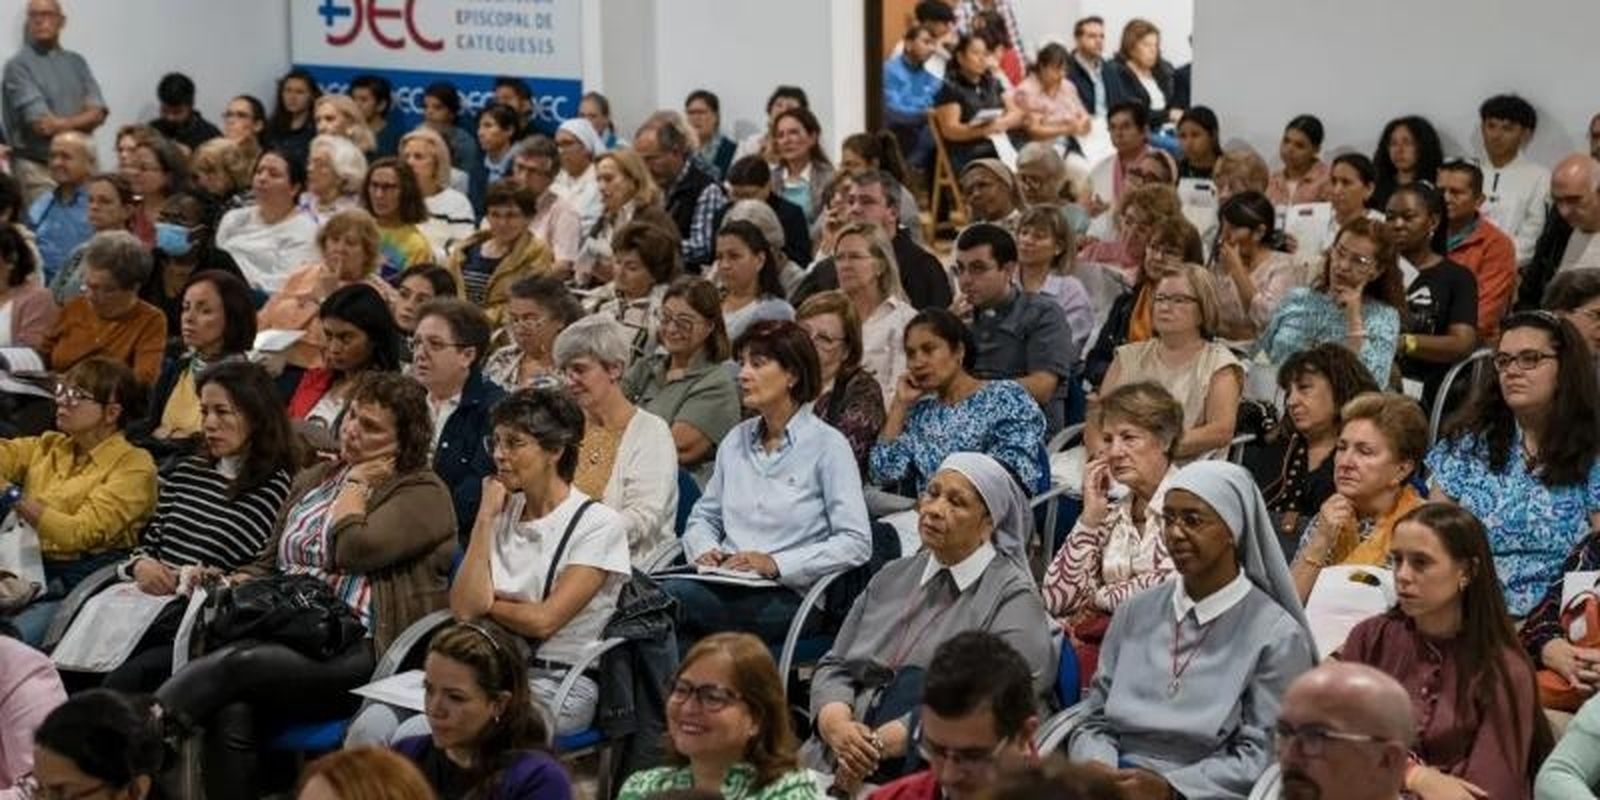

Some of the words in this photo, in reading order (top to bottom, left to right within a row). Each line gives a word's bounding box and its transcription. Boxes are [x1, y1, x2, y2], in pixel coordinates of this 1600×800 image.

[455, 9, 529, 29] EPISCOPAL
[534, 13, 553, 30] DE
[455, 34, 555, 54] CATEQUESIS
